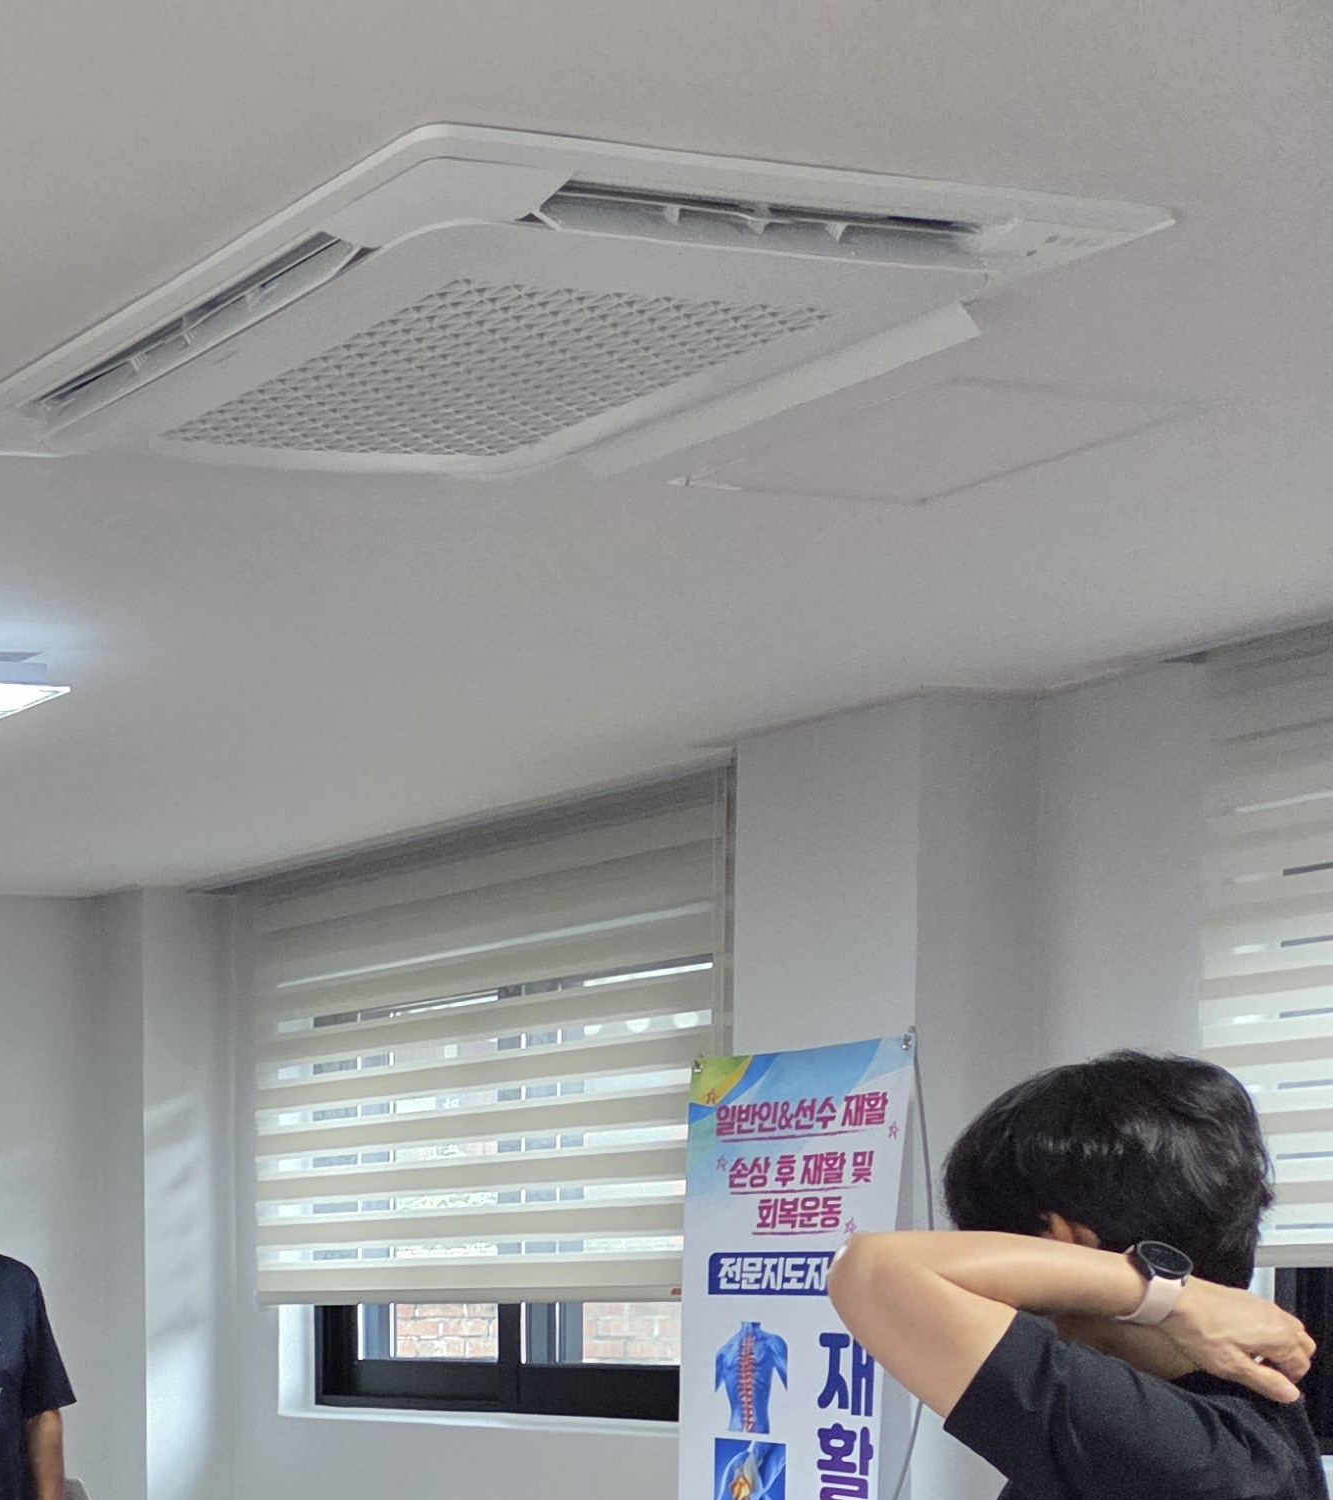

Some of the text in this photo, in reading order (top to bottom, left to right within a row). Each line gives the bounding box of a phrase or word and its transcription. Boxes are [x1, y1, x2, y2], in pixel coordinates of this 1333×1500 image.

[716, 1091, 889, 1137] 일반인&선수 재활
[728, 1150, 875, 1189] 손상 후 재활 및
[756, 1196, 843, 1230] 회복운동
